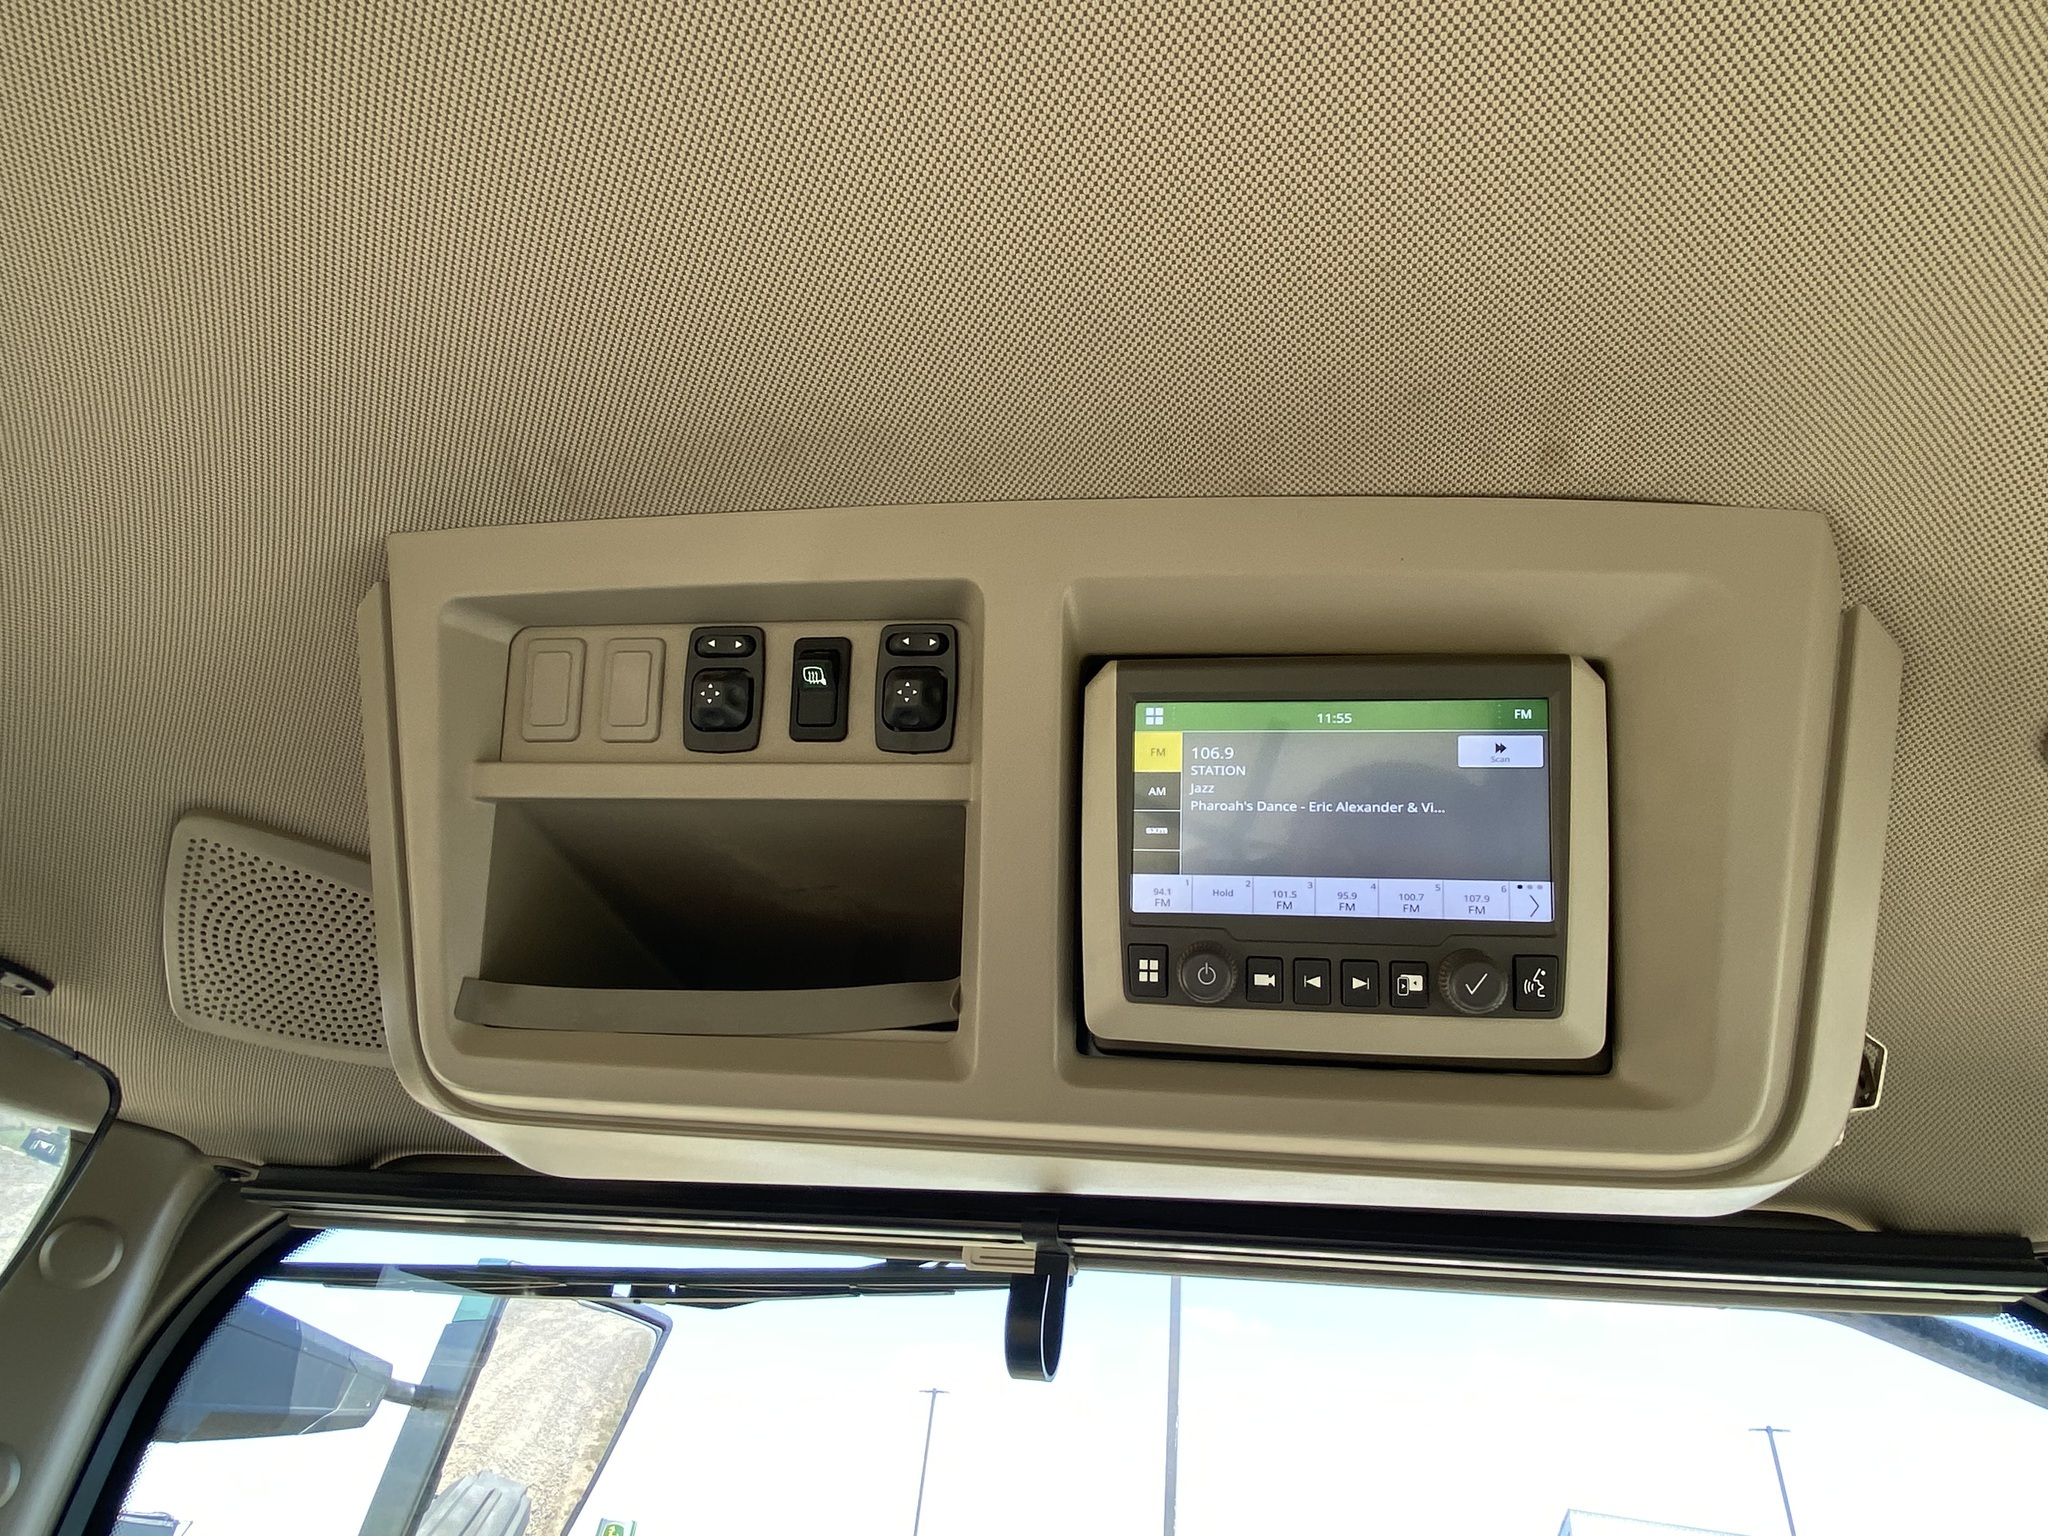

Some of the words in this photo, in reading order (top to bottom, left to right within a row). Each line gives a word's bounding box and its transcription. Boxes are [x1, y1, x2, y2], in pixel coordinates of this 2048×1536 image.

[1317, 713, 1352, 723] 11:55
[1514, 709, 1532, 720] FM
[1150, 748, 1166, 757] FM
[1191, 747, 1234, 759] 106.9
[1490, 755, 1511, 763] Scan
[1191, 765, 1246, 776] STATION
[1148, 786, 1166, 796] AM
[1190, 783, 1215, 794] Jazz
[1191, 800, 1254, 811] Pharoah's
[1256, 801, 1297, 812] Dance
[1309, 801, 1333, 812] Eric
[1336, 801, 1403, 812] Alexander
[1407, 802, 1418, 813] &
[1153, 888, 1172, 896] 94.1
[1212, 889, 1234, 897] Hold
[1272, 890, 1297, 899] 101.5
[1337, 892, 1358, 900] 95.9
[1398, 893, 1424, 902] 100.7
[1463, 895, 1490, 903] 107.9
[1154, 898, 1171, 907] FM
[1276, 901, 1293, 910] FM
[1339, 902, 1356, 911] FM
[1403, 903, 1420, 913] FM
[1468, 905, 1486, 915] FM
